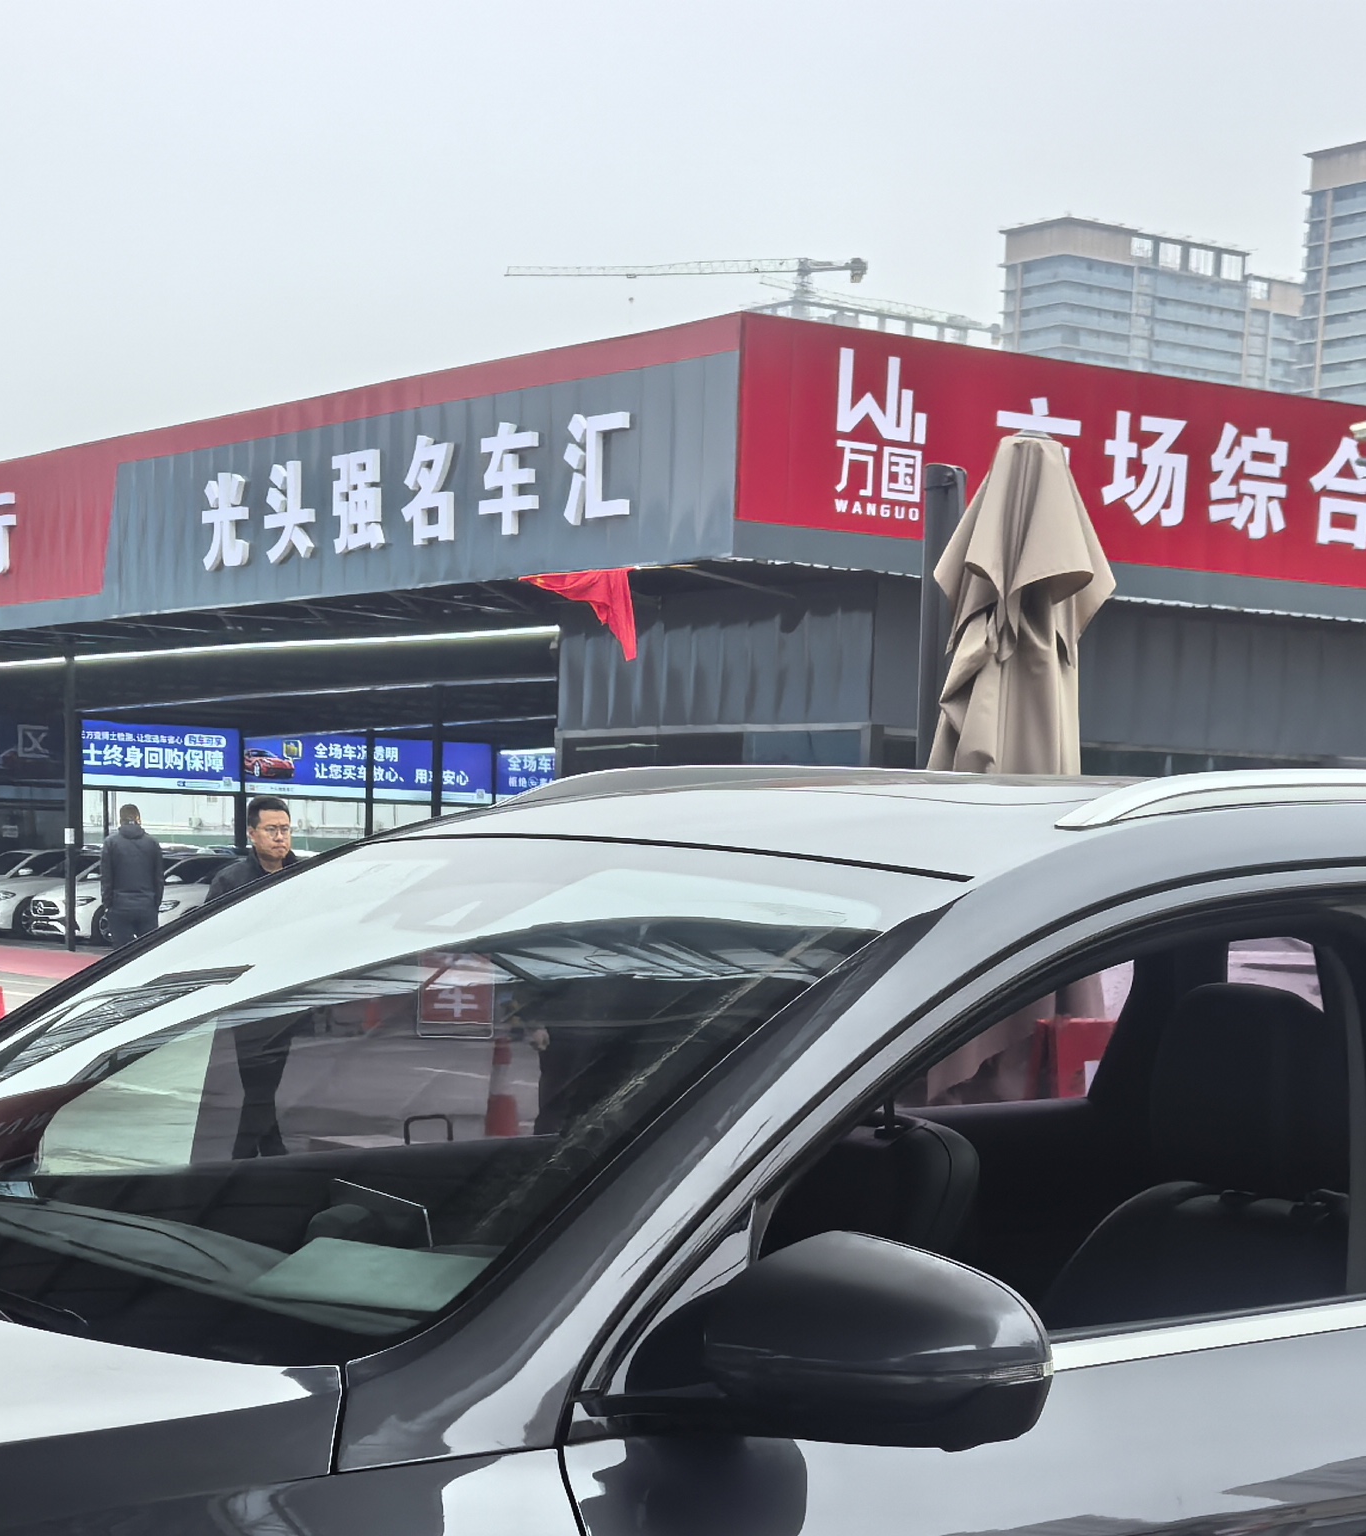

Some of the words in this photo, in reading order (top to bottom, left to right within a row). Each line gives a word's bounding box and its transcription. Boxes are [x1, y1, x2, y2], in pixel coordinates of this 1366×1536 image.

[201, 410, 631, 572] 光头强名车汇
[835, 439, 923, 503] 万国
[834, 498, 920, 521] WANGUO
[508, 754, 555, 773] 全场车
